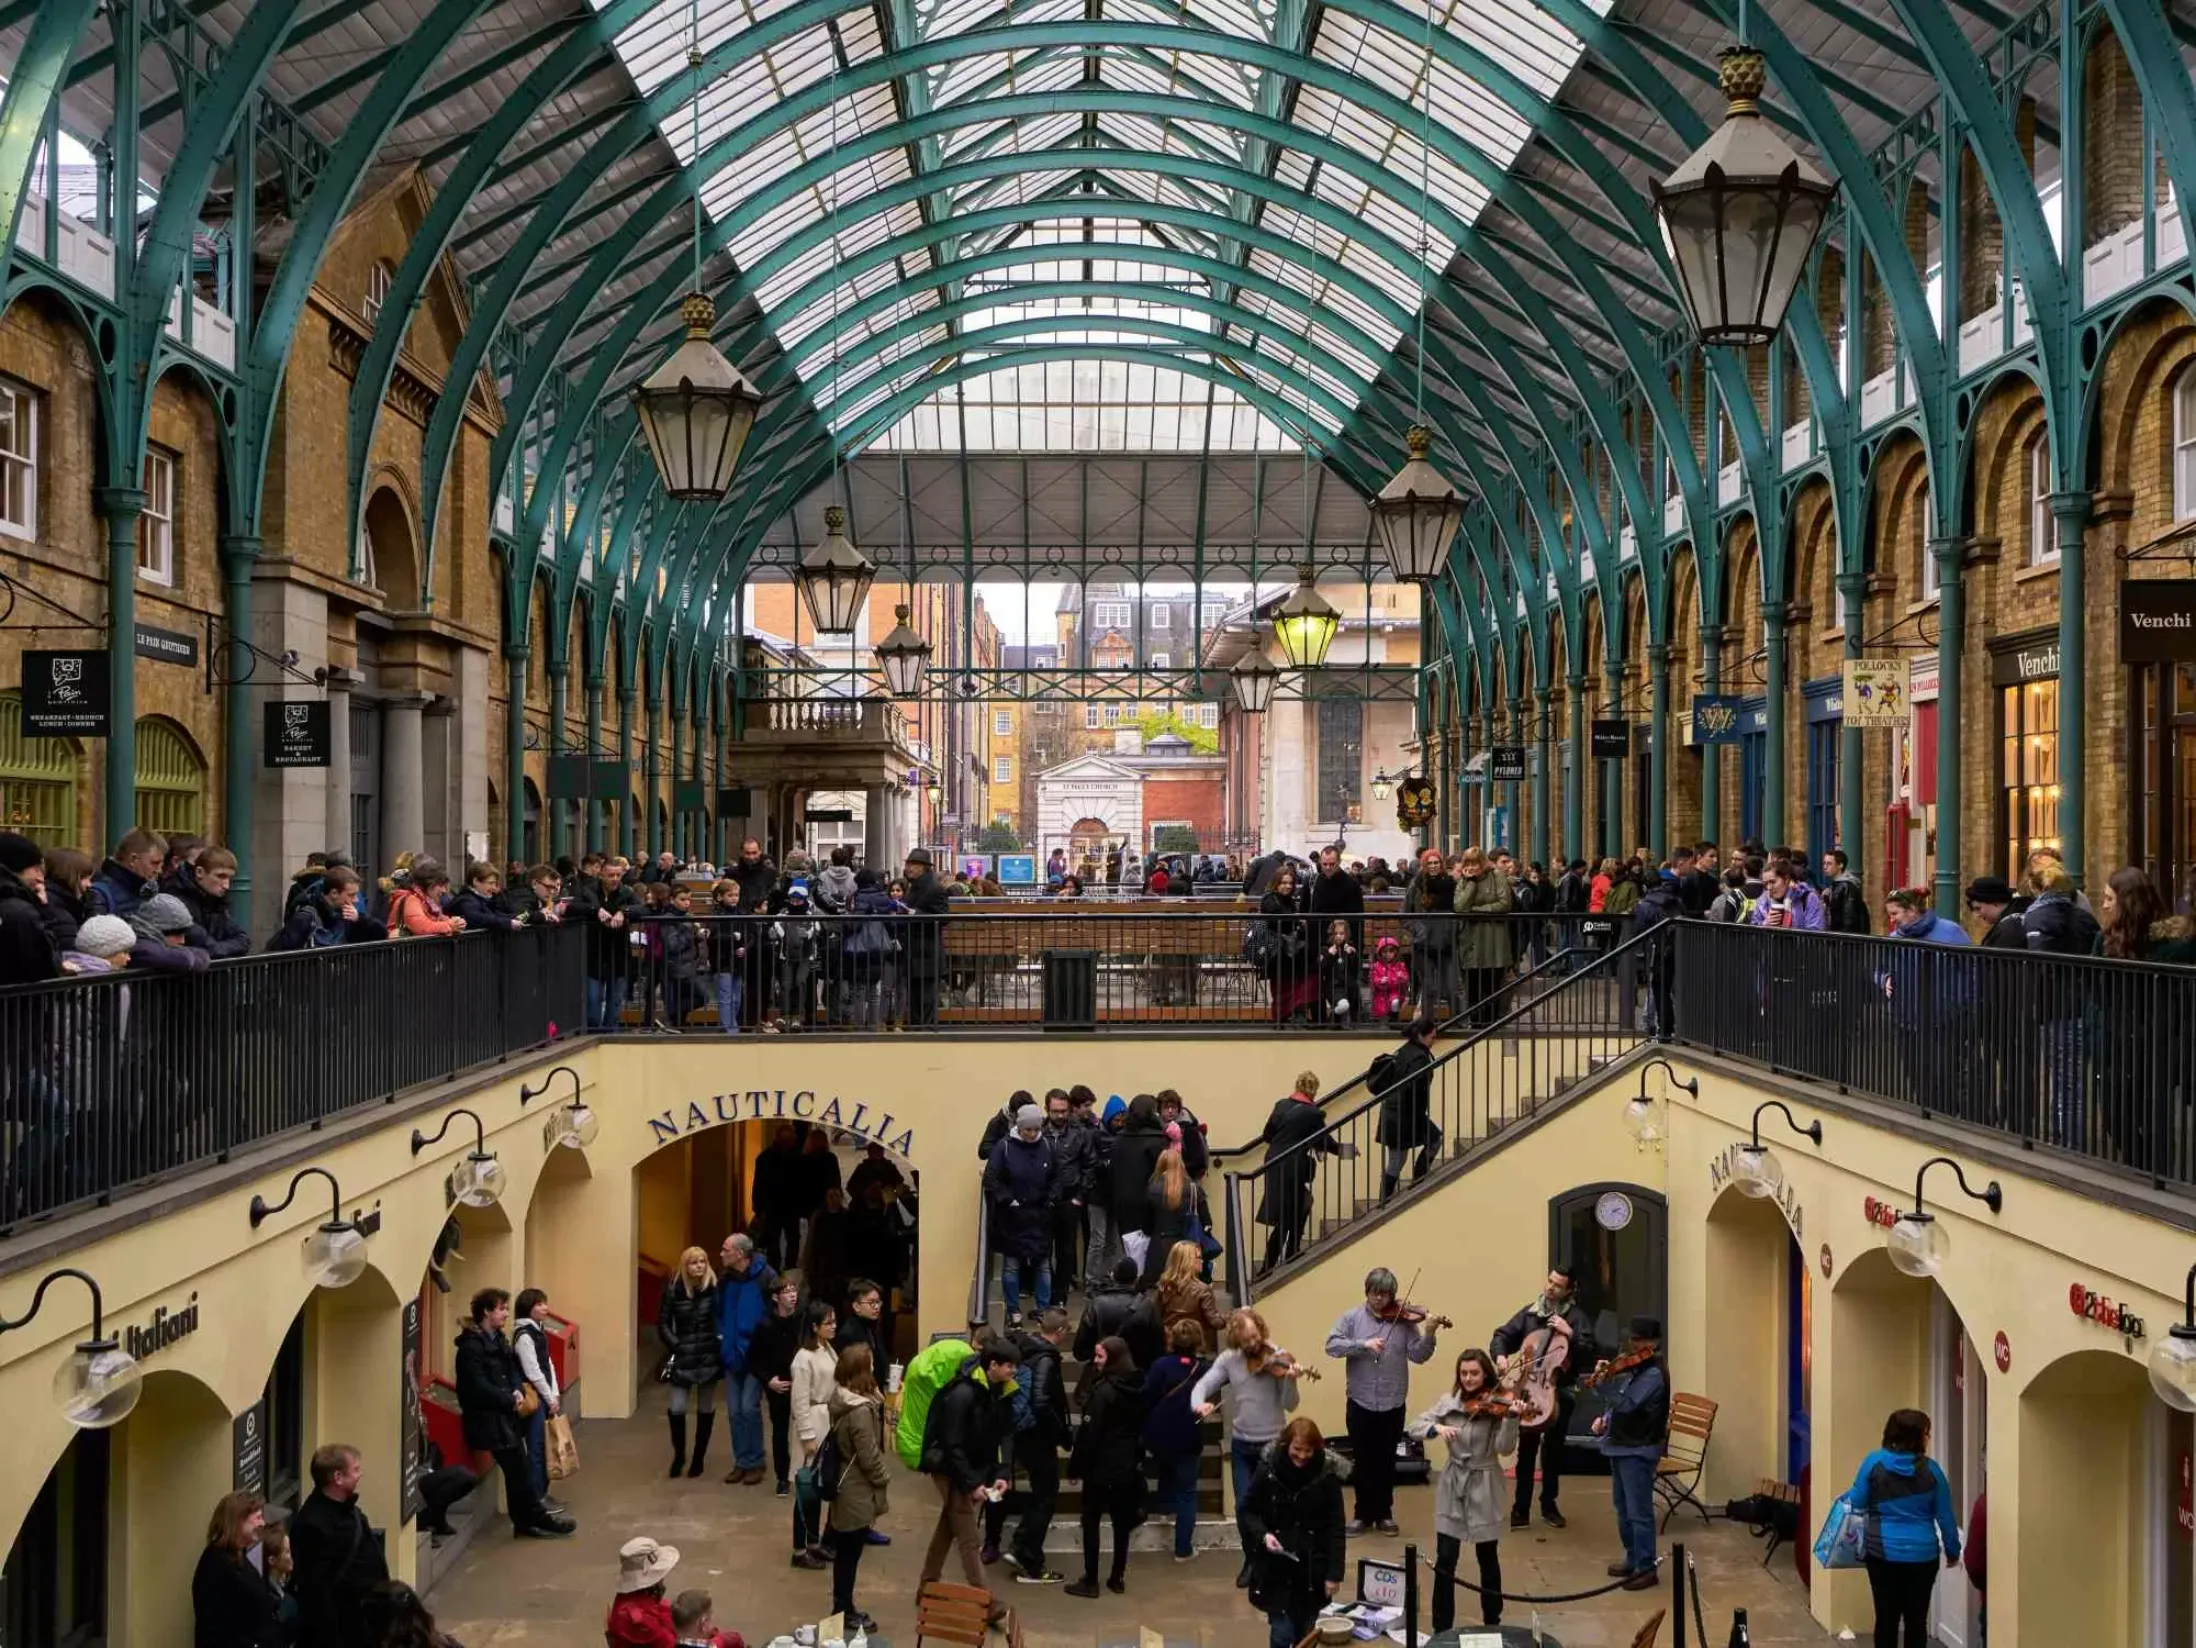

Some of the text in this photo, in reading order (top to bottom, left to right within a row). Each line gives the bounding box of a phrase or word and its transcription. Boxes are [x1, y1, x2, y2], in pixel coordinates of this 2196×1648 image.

[2130, 612, 2192, 628] Venchi
[2017, 646, 2060, 678] Venchi
[647, 1090, 914, 1157] NAUTICALIA
[126, 1291, 199, 1362] Italiani
[1995, 1339, 2009, 1362] WC
[1374, 1570, 1398, 1584] CDs
